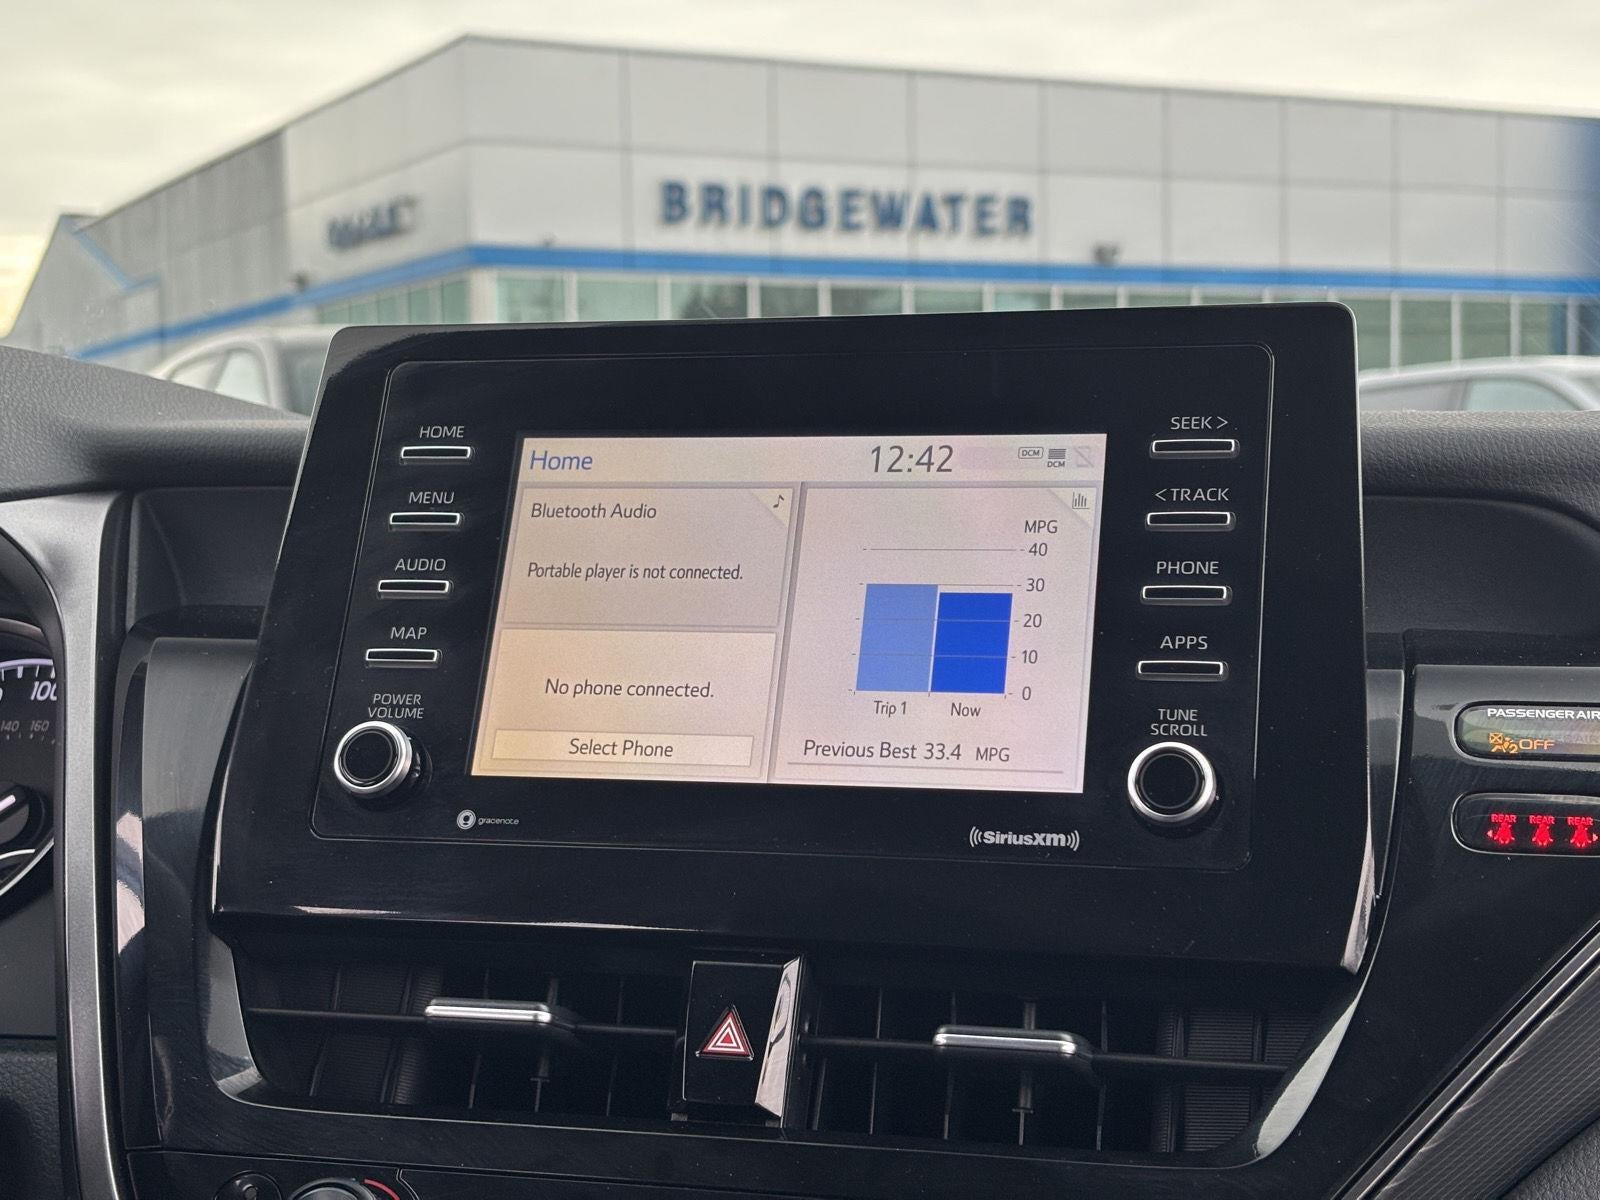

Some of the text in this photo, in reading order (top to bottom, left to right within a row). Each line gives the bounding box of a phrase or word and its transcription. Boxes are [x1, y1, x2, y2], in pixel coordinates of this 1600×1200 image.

[660, 180, 1033, 238] BRIDGEWATER
[419, 425, 465, 439] HOME
[529, 449, 593, 471] Home
[870, 444, 954, 473] 12:42
[1021, 449, 1040, 457] DCM
[1047, 460, 1066, 468] DCM
[408, 491, 455, 505] MENU
[530, 503, 657, 519] Bluetooth Audio
[1023, 519, 1058, 535] MPG
[1028, 543, 1049, 557] 40
[394, 558, 446, 572] AUDIO
[527, 561, 744, 582] Portable player is not connected.
[1156, 561, 1219, 576] PHONE
[1025, 578, 1046, 593] 30
[1023, 614, 1043, 629] 20
[390, 626, 428, 640] MAP
[1160, 635, 1209, 650] APPS
[1023, 650, 1039, 665] 10
[544, 678, 715, 699] No phone connected.
[1021, 686, 1033, 701] 0
[372, 693, 422, 706] POWER
[367, 707, 424, 720] VOLUME
[874, 700, 907, 718] Trip 1
[950, 702, 982, 717] Now
[1157, 708, 1198, 722] TUNE
[1487, 708, 1600, 720] PASSENGER AIR
[0, 719, 50, 732] 140 160
[1150, 722, 1208, 737] SCROLL
[568, 738, 674, 758] Select Phone
[803, 739, 1010, 762] Previous Best 33.4 MPG
[1519, 738, 1555, 750] OFF
[478, 817, 520, 826] gracenote
[1490, 813, 1518, 823] REAR
[1529, 815, 1555, 824] REAR
[1567, 816, 1594, 825] REAR
